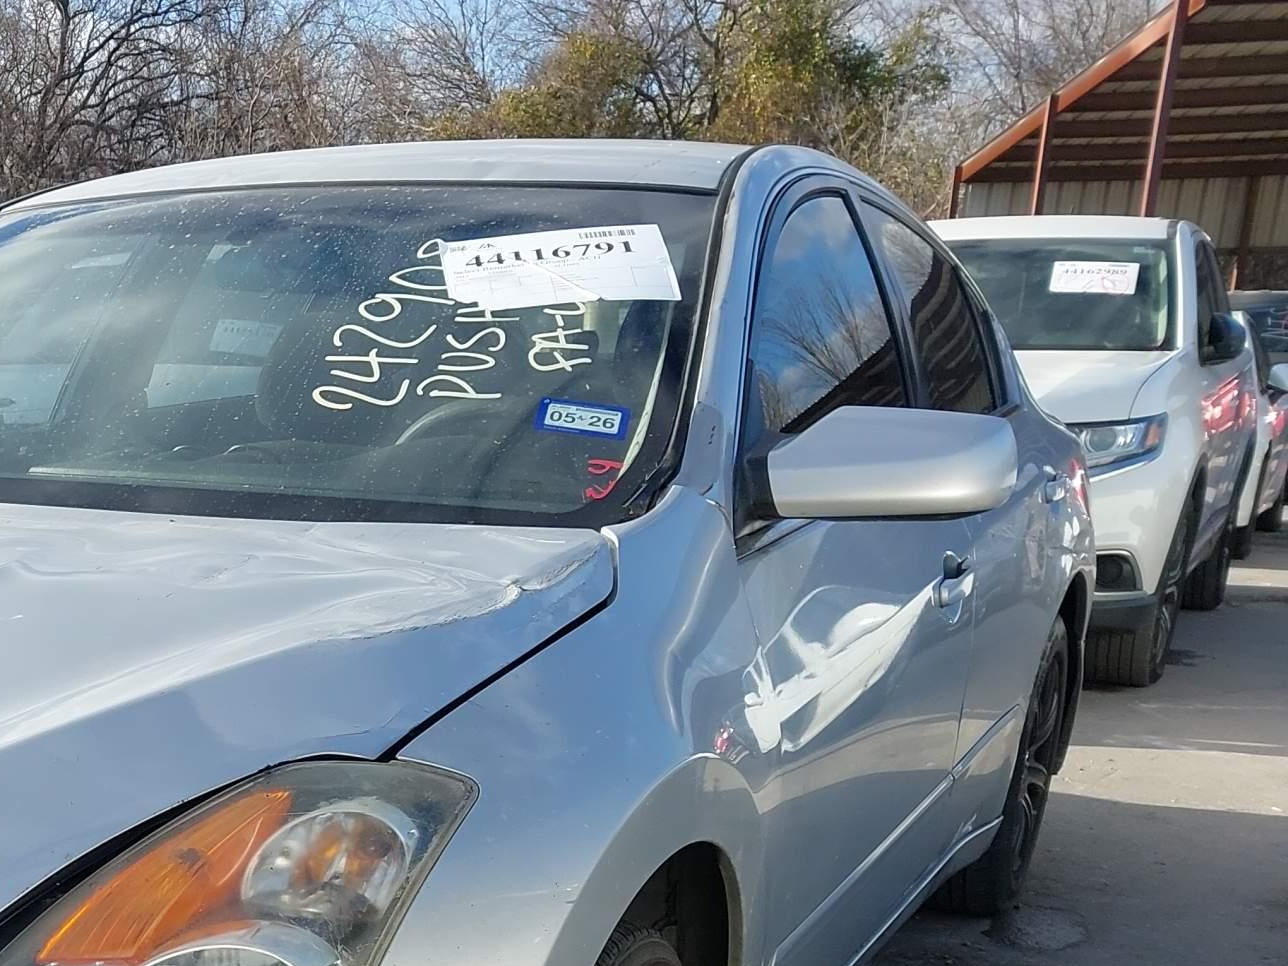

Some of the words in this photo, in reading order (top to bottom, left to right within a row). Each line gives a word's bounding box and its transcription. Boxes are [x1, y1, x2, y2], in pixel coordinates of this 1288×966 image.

[465, 239, 636, 268] 44116791
[549, 410, 577, 424] 05
[587, 415, 616, 430] 26
